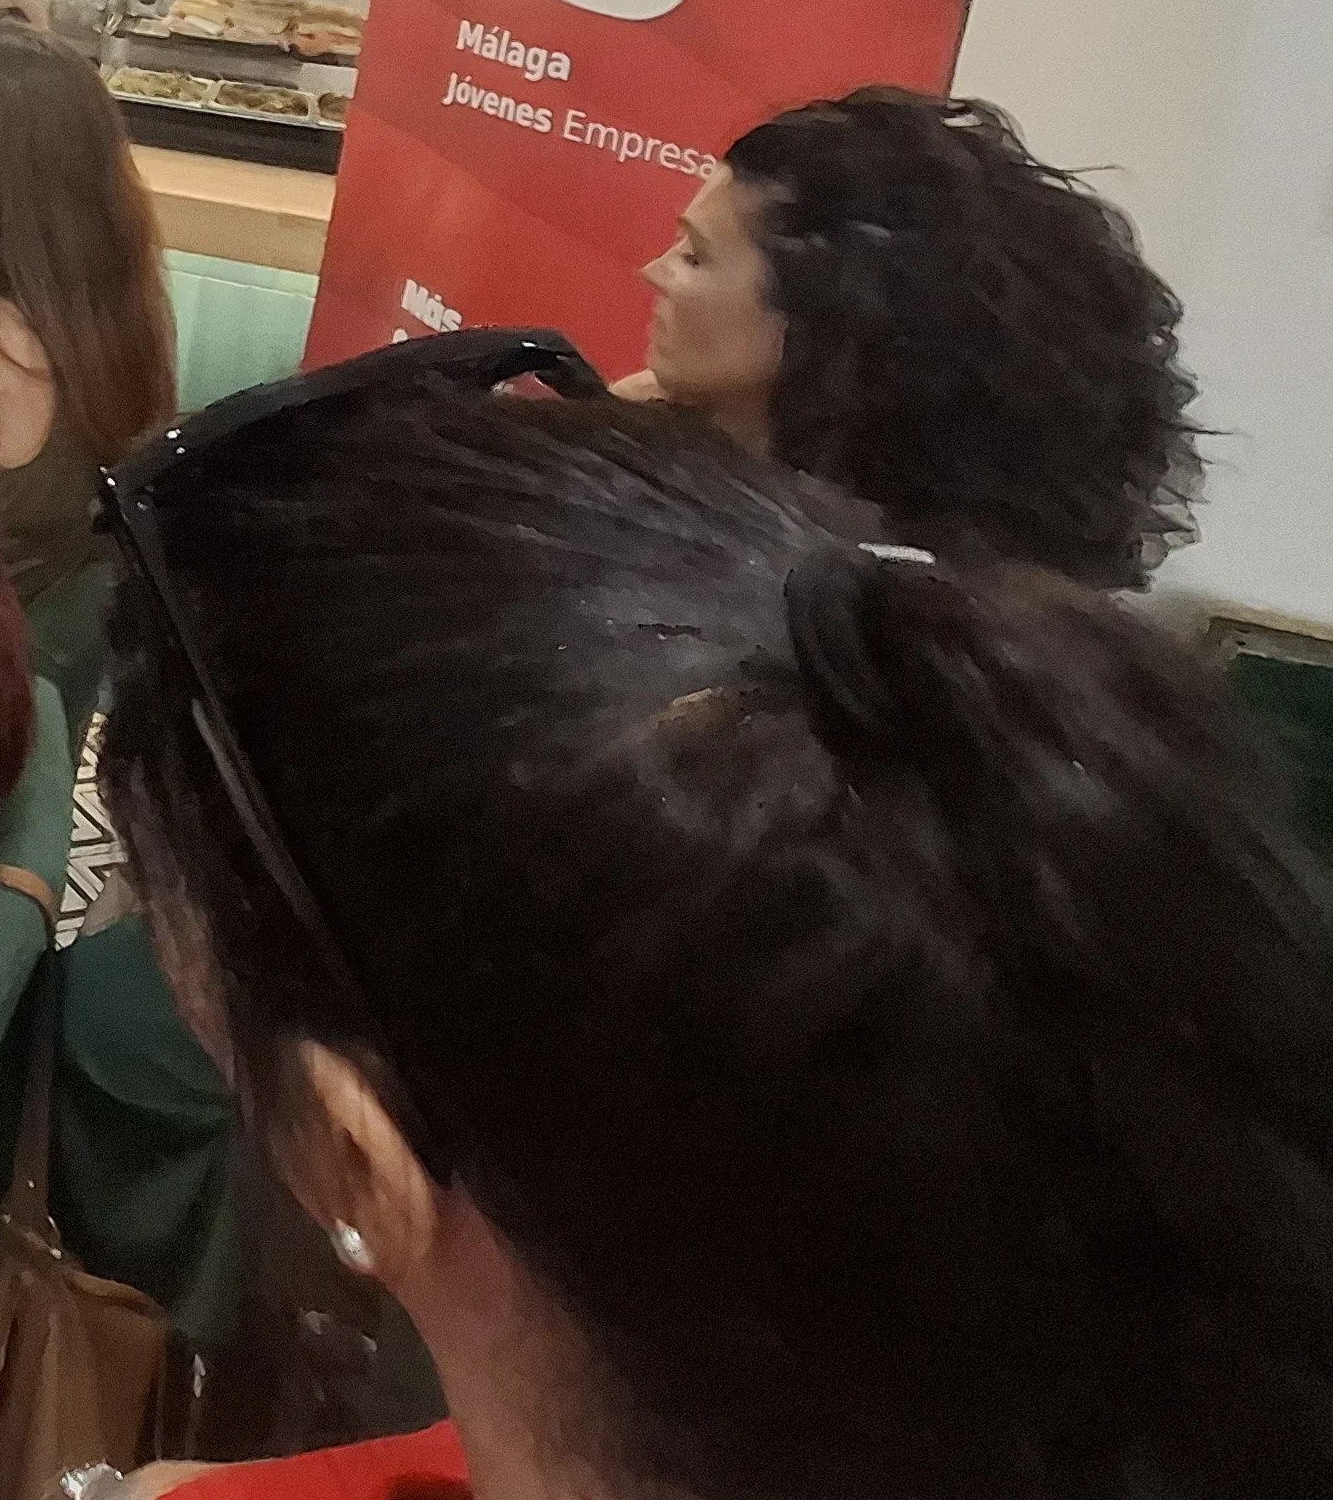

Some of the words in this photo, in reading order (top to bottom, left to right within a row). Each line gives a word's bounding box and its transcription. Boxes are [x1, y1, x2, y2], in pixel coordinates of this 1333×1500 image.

[455, 19, 572, 82] Málaga
[441, 72, 554, 133] Jóvenes
[563, 108, 718, 179] Empresa
